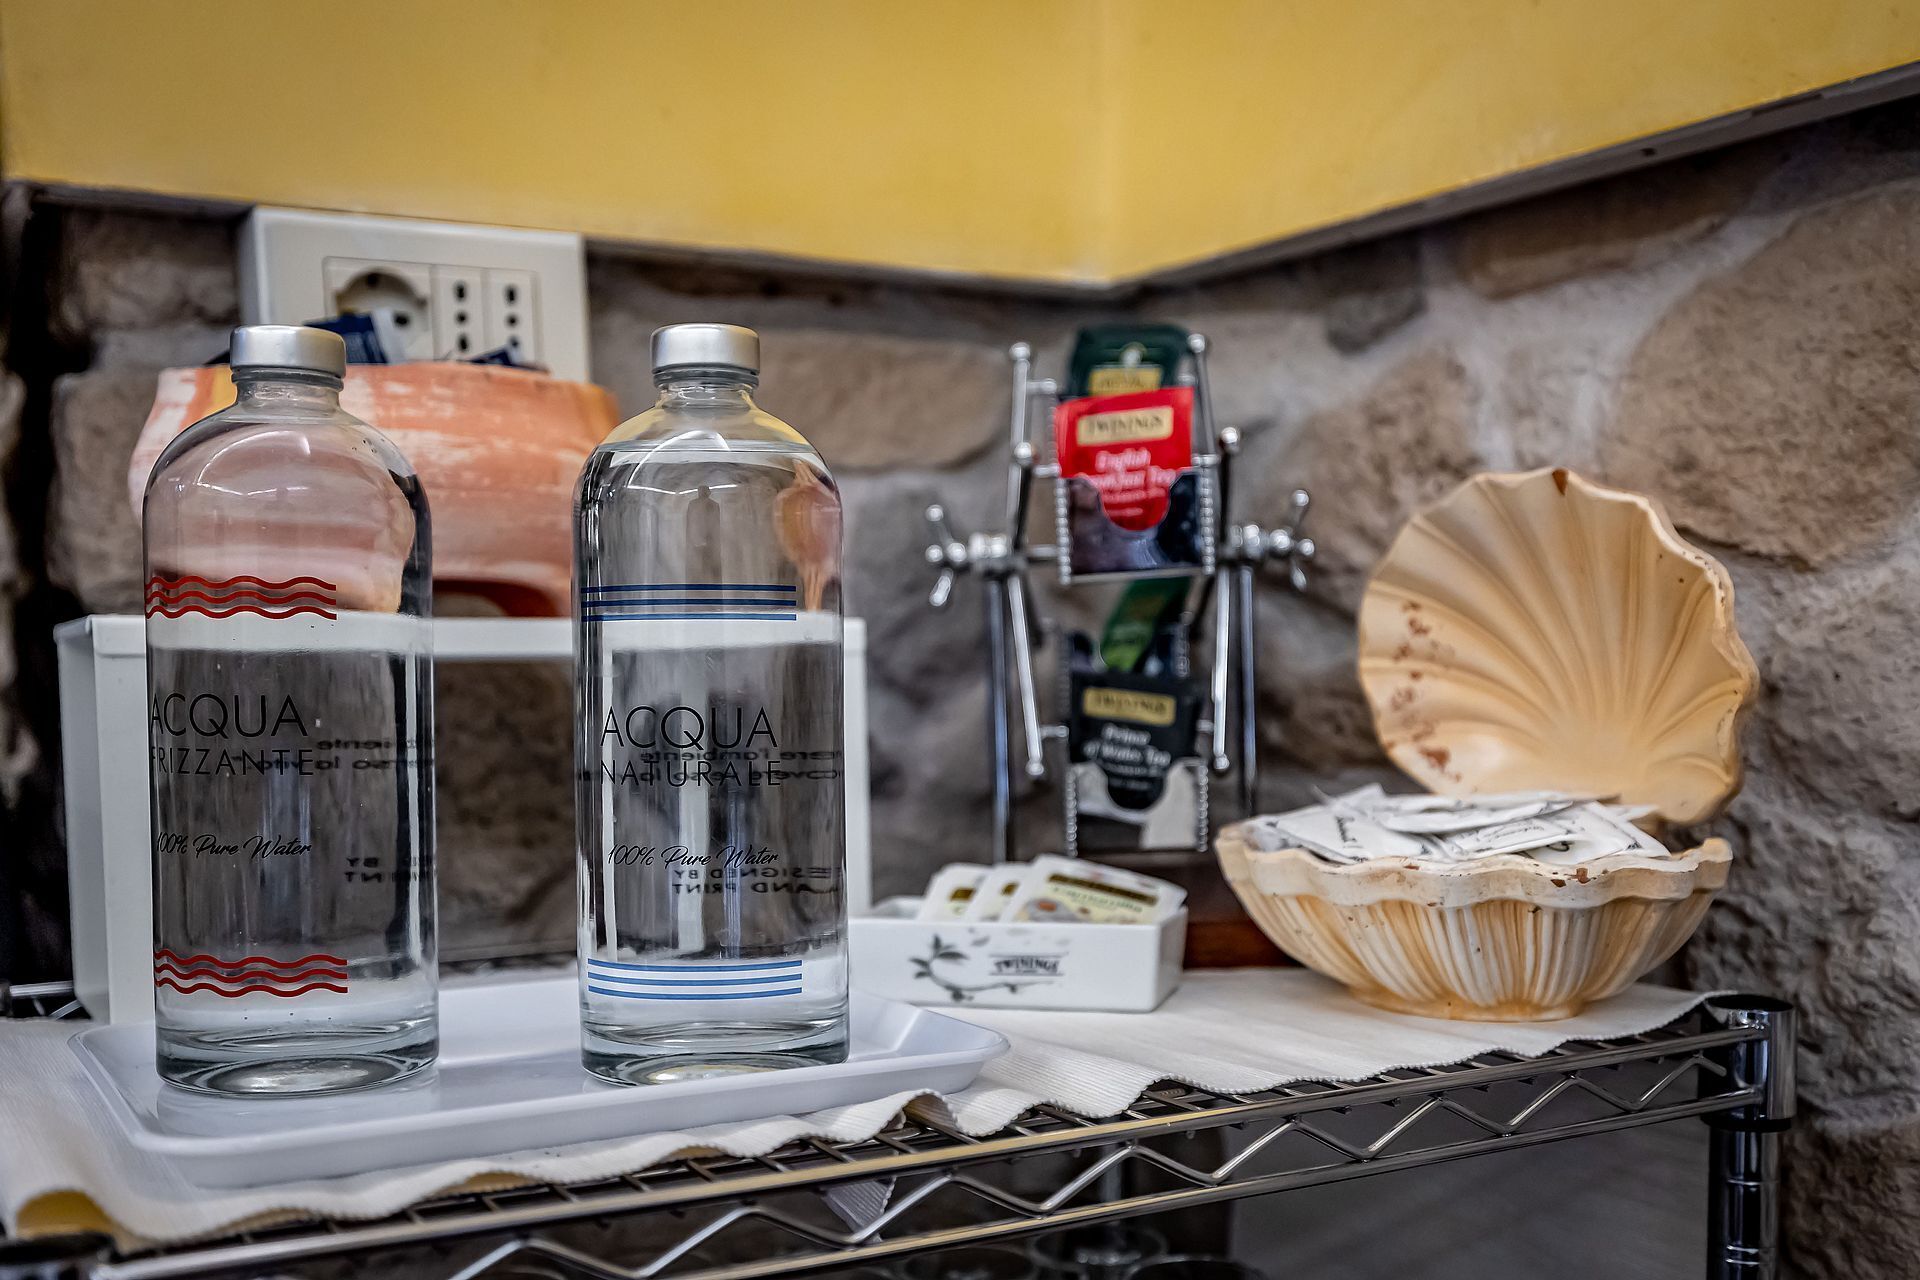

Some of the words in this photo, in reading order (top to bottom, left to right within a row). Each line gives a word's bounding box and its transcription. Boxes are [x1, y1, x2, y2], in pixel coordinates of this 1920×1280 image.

[150, 692, 309, 739] ACQUA
[600, 705, 778, 750] ACQUA
[151, 746, 314, 777] FRIZZANTE
[600, 759, 782, 787] NATURALE
[157, 832, 189, 856] 100%
[192, 833, 240, 859] Pure
[243, 834, 313, 860] Water
[608, 844, 655, 866] 100%
[660, 845, 712, 870] Pure
[716, 845, 779, 869] Water
[993, 956, 1060, 974] TWININGS
